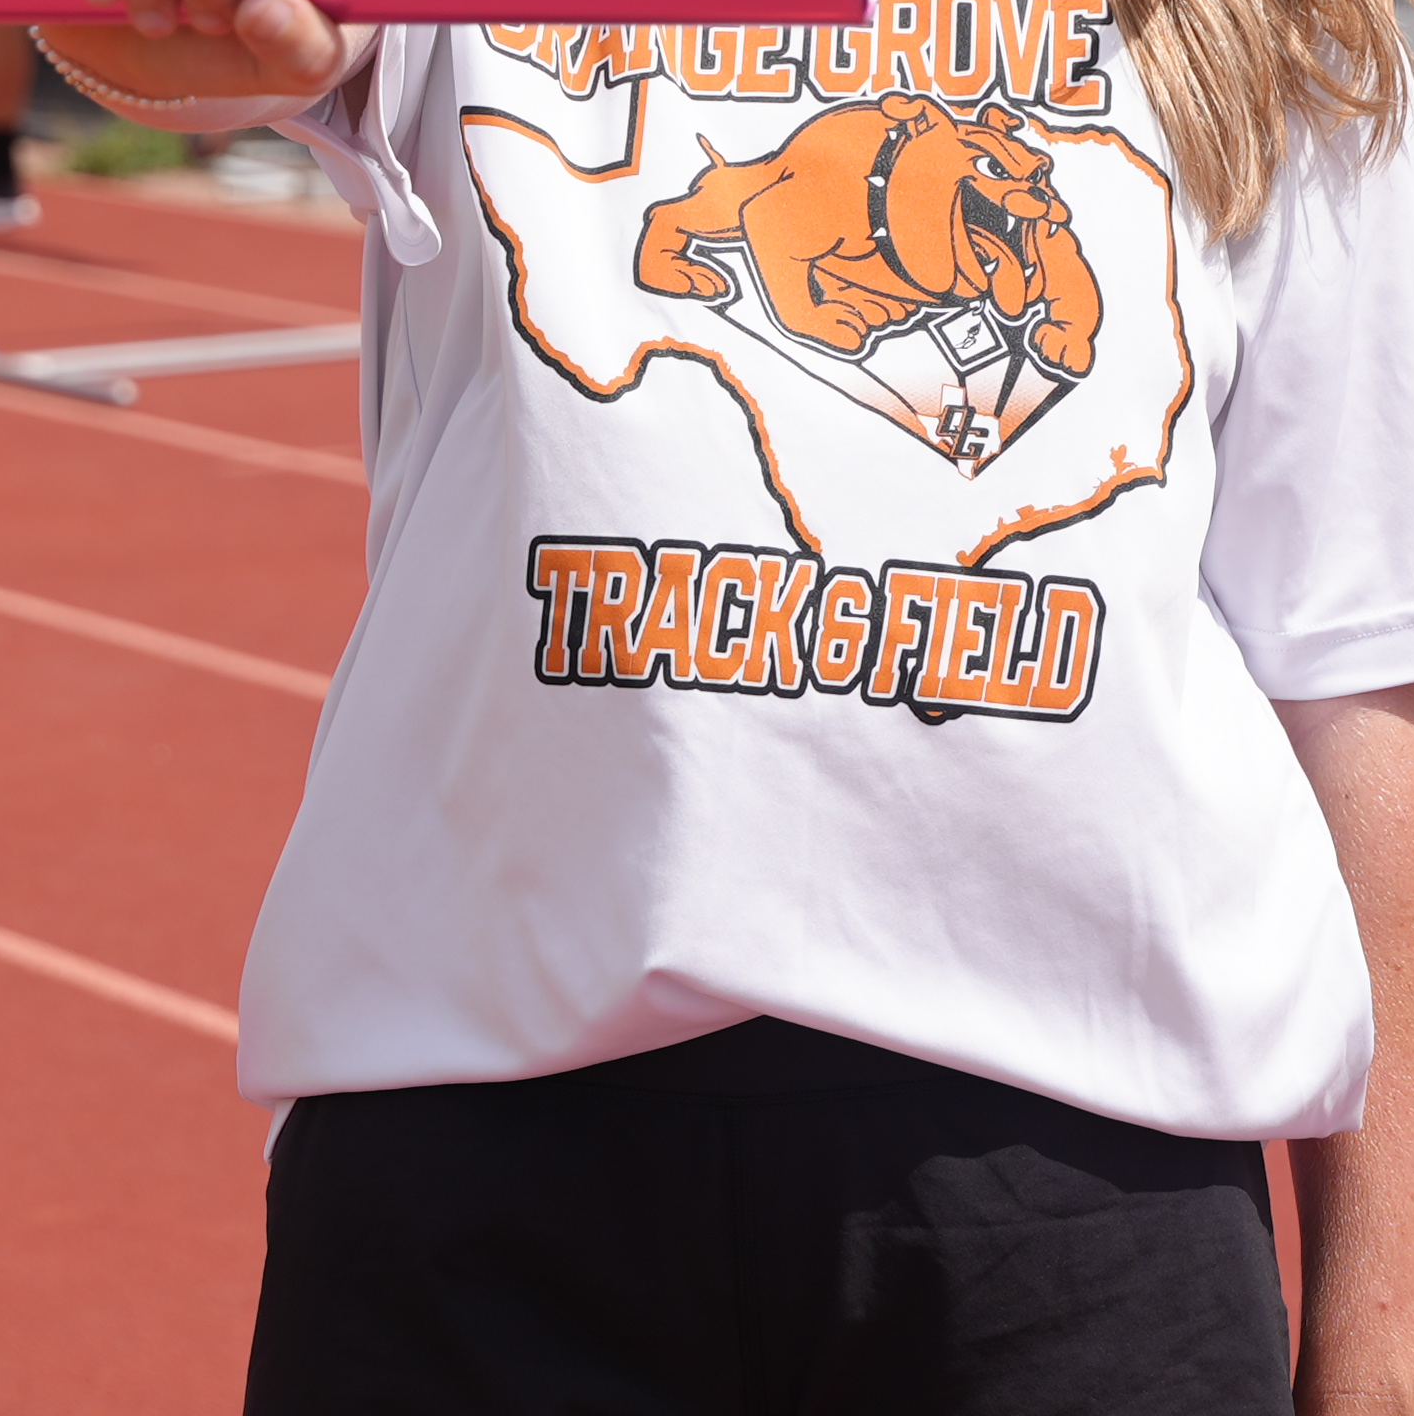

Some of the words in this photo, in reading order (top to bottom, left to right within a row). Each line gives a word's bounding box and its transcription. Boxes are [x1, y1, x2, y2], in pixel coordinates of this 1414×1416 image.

[483, 24, 795, 97] RANGE
[534, 542, 818, 691] TRACK
[813, 577, 875, 686] &
[868, 567, 1101, 715] FIELD
